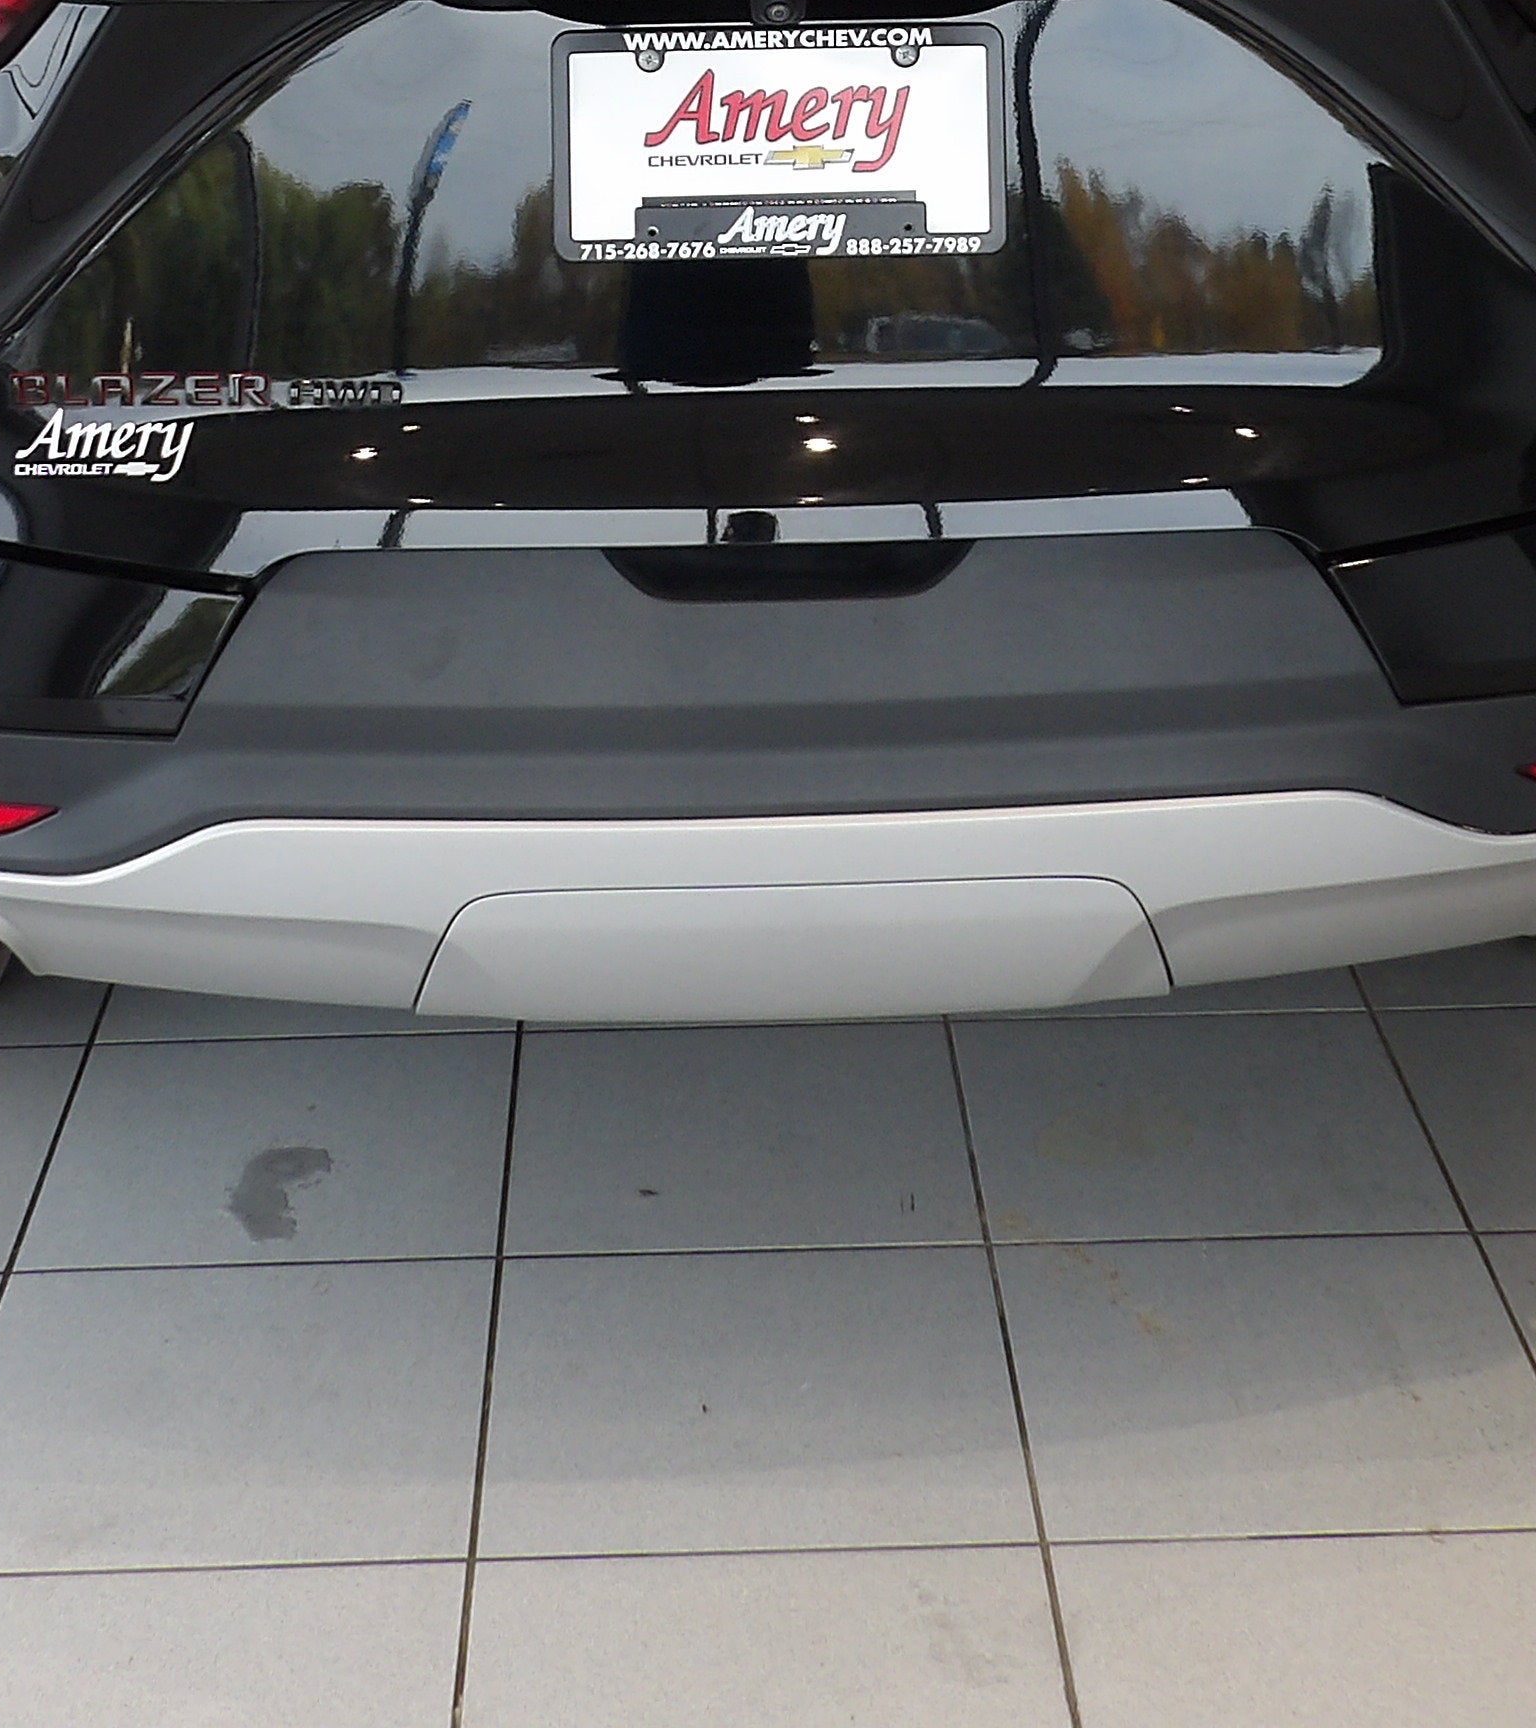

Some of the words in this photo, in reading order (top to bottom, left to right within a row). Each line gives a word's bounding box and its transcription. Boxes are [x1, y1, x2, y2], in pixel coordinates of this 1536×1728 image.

[623, 28, 933, 50] WWW.AMERYCHEV.COM
[644, 69, 911, 173] Amery
[648, 153, 763, 167] CHEVROLET
[717, 206, 846, 256] Amery
[580, 241, 716, 260] 715-268-7676
[845, 237, 982, 256] 888-257-7989
[10, 372, 270, 407] BLAZER
[289, 379, 403, 406] AWD
[15, 407, 195, 483] Amery
[14, 463, 114, 476] CHEVROLET
